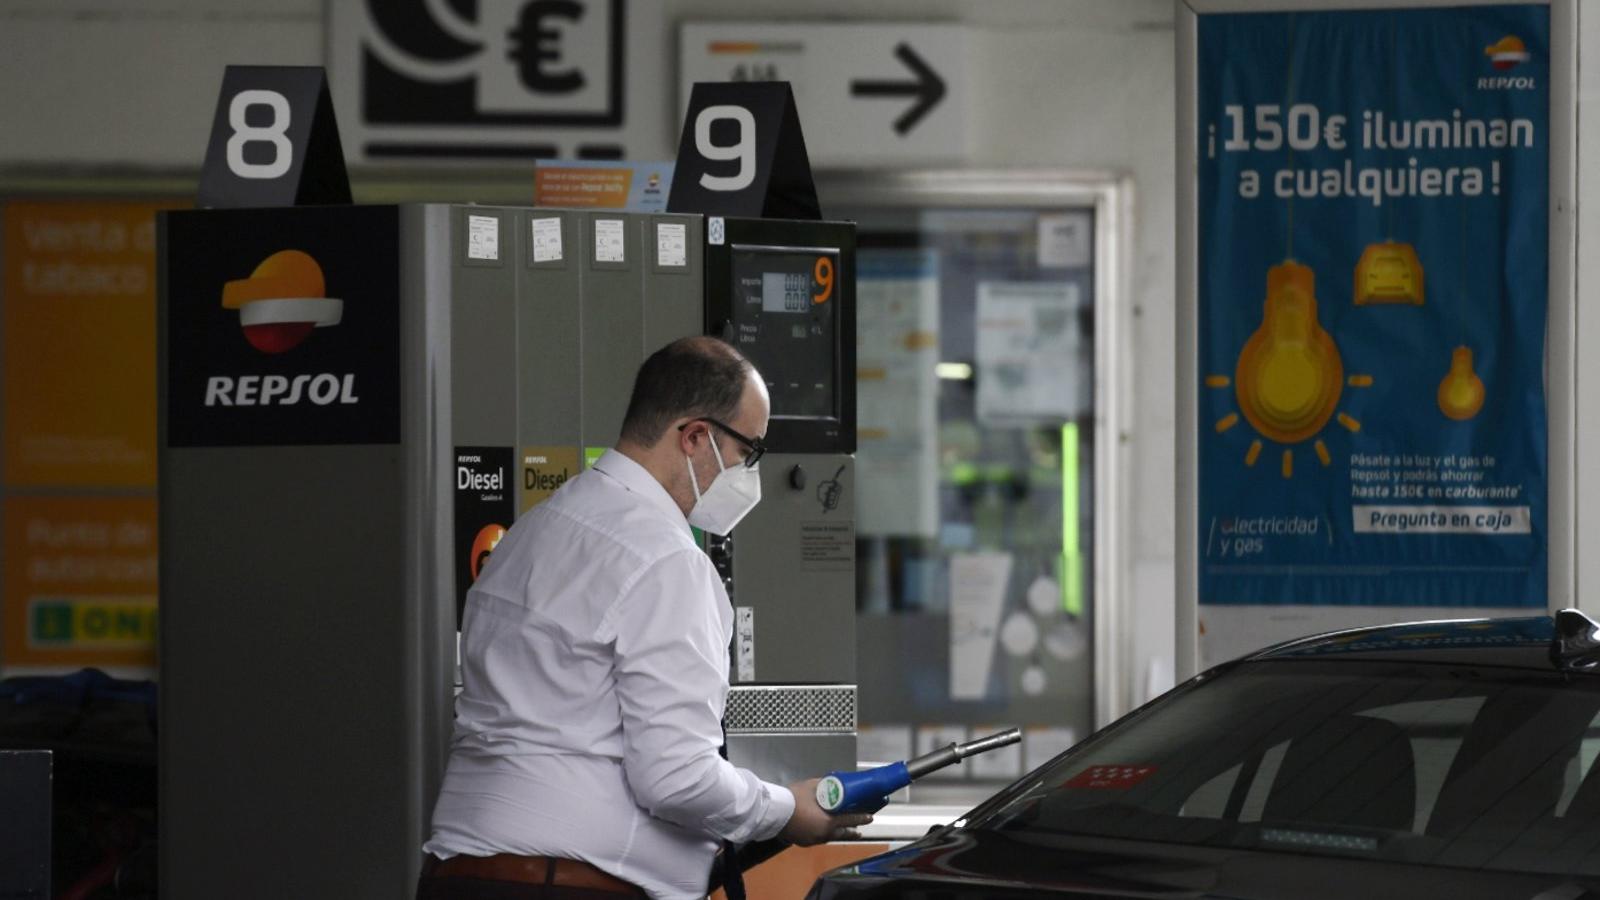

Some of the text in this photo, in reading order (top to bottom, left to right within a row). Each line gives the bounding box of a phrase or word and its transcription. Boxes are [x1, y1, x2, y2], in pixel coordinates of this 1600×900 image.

[1478, 77, 1534, 90] REPSOL
[226, 90, 292, 179] 8
[1362, 109, 1535, 149] iluminan
[694, 105, 757, 191] 9
[1239, 169, 1260, 198] a
[814, 257, 833, 303] 9
[204, 373, 359, 406] REPSOL
[1351, 454, 1496, 468] Pásate a la luz y el gas de
[457, 467, 504, 490] Diesel
[1351, 469, 1390, 482] Repsol
[1393, 472, 1401, 482] y
[1441, 469, 1484, 480] ahorrar
[1352, 485, 1389, 497] hasta
[1393, 486, 1424, 497] 150€
[1428, 488, 1442, 497] en
[1370, 511, 1512, 530] Pregunta en caja
[1220, 539, 1263, 556] y gas
